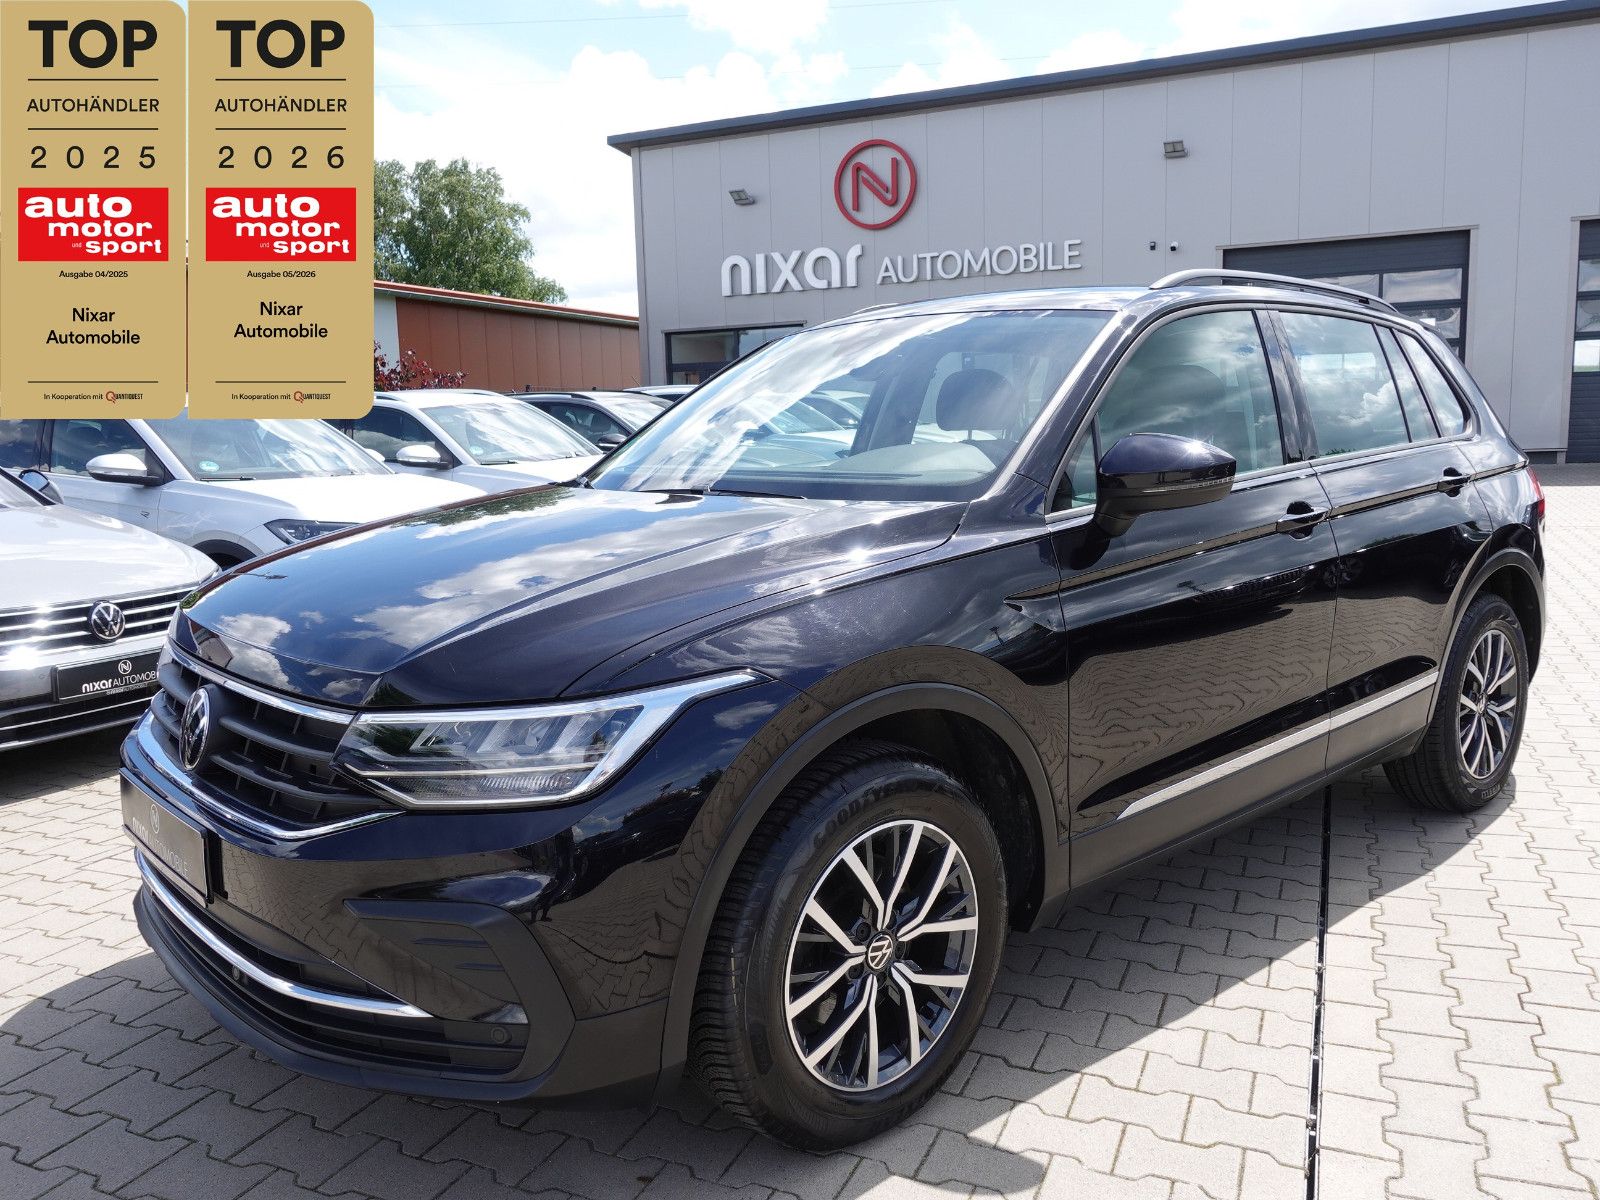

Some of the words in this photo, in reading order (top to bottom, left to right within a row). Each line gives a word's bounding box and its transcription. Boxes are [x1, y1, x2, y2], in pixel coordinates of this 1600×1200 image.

[721, 243, 863, 297] nixar
[876, 239, 1083, 285] AUTOMOBILE
[82, 679, 113, 693] nixar
[113, 670, 159, 688] AUTOMOB
